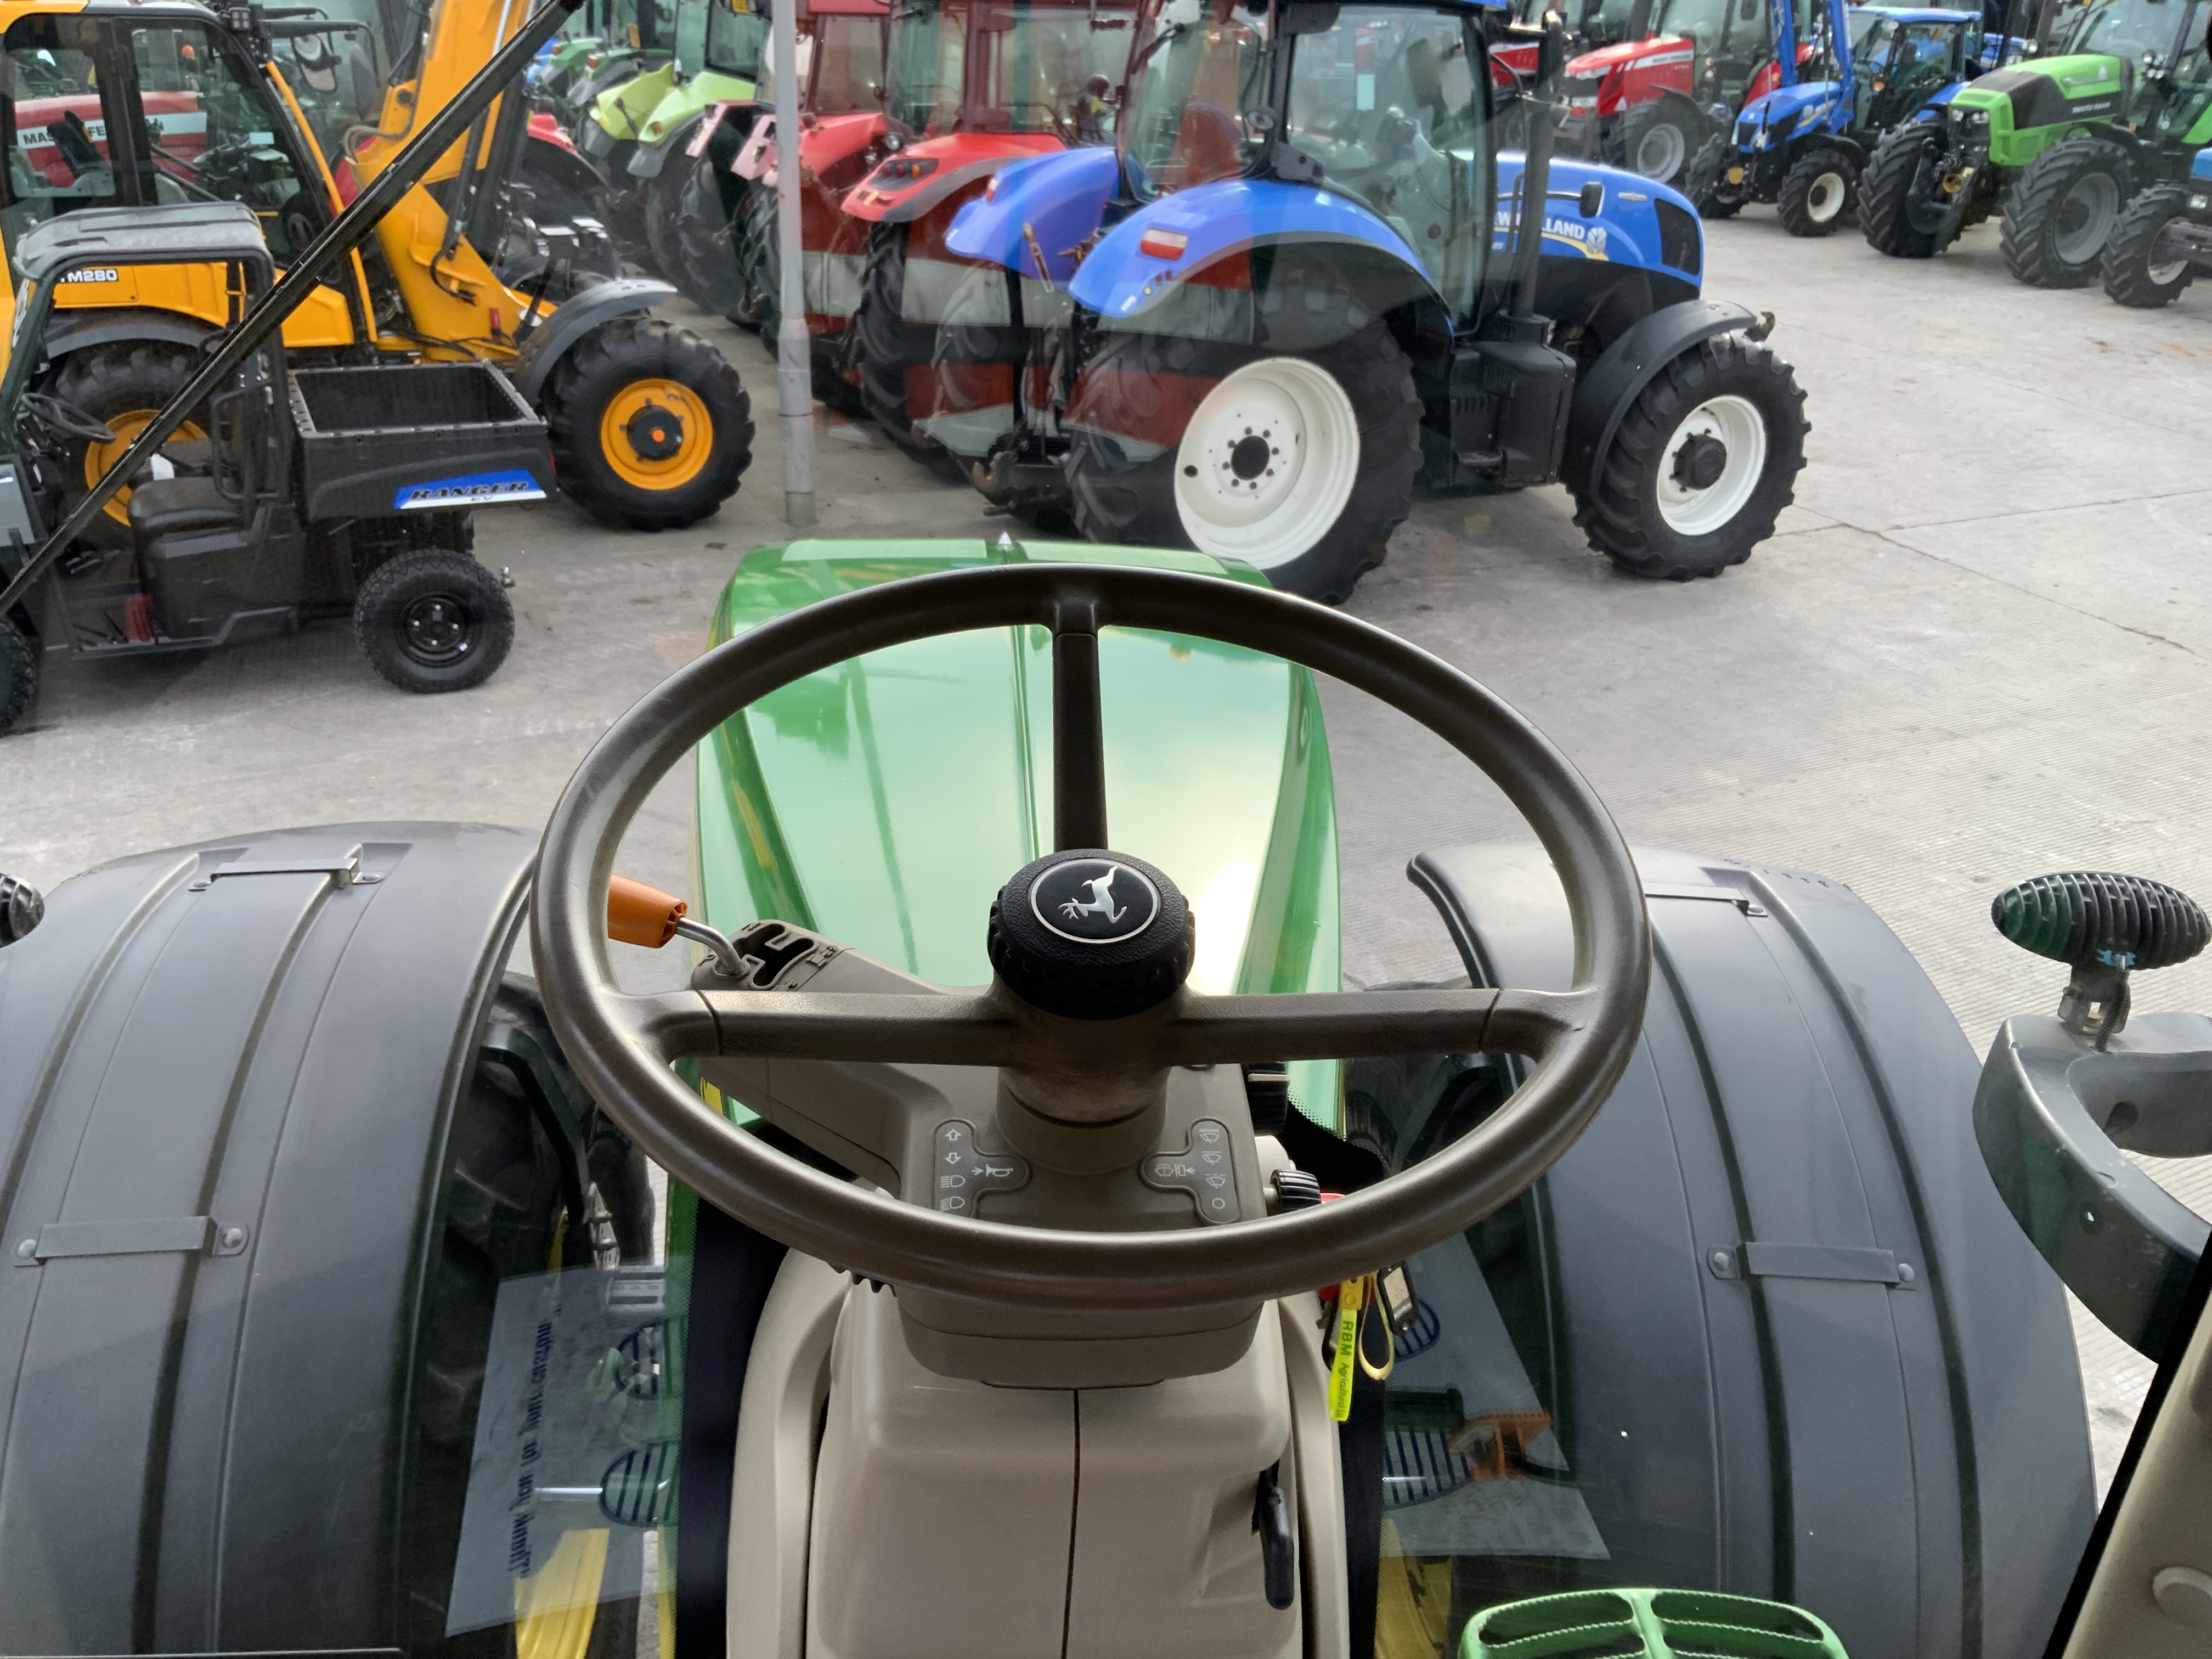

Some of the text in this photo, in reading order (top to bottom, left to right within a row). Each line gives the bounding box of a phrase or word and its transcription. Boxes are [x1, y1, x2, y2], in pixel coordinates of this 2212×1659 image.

[61, 269, 118, 283] M280
[411, 482, 528, 500] RANGER
[1340, 1321, 1354, 1356] RBM
